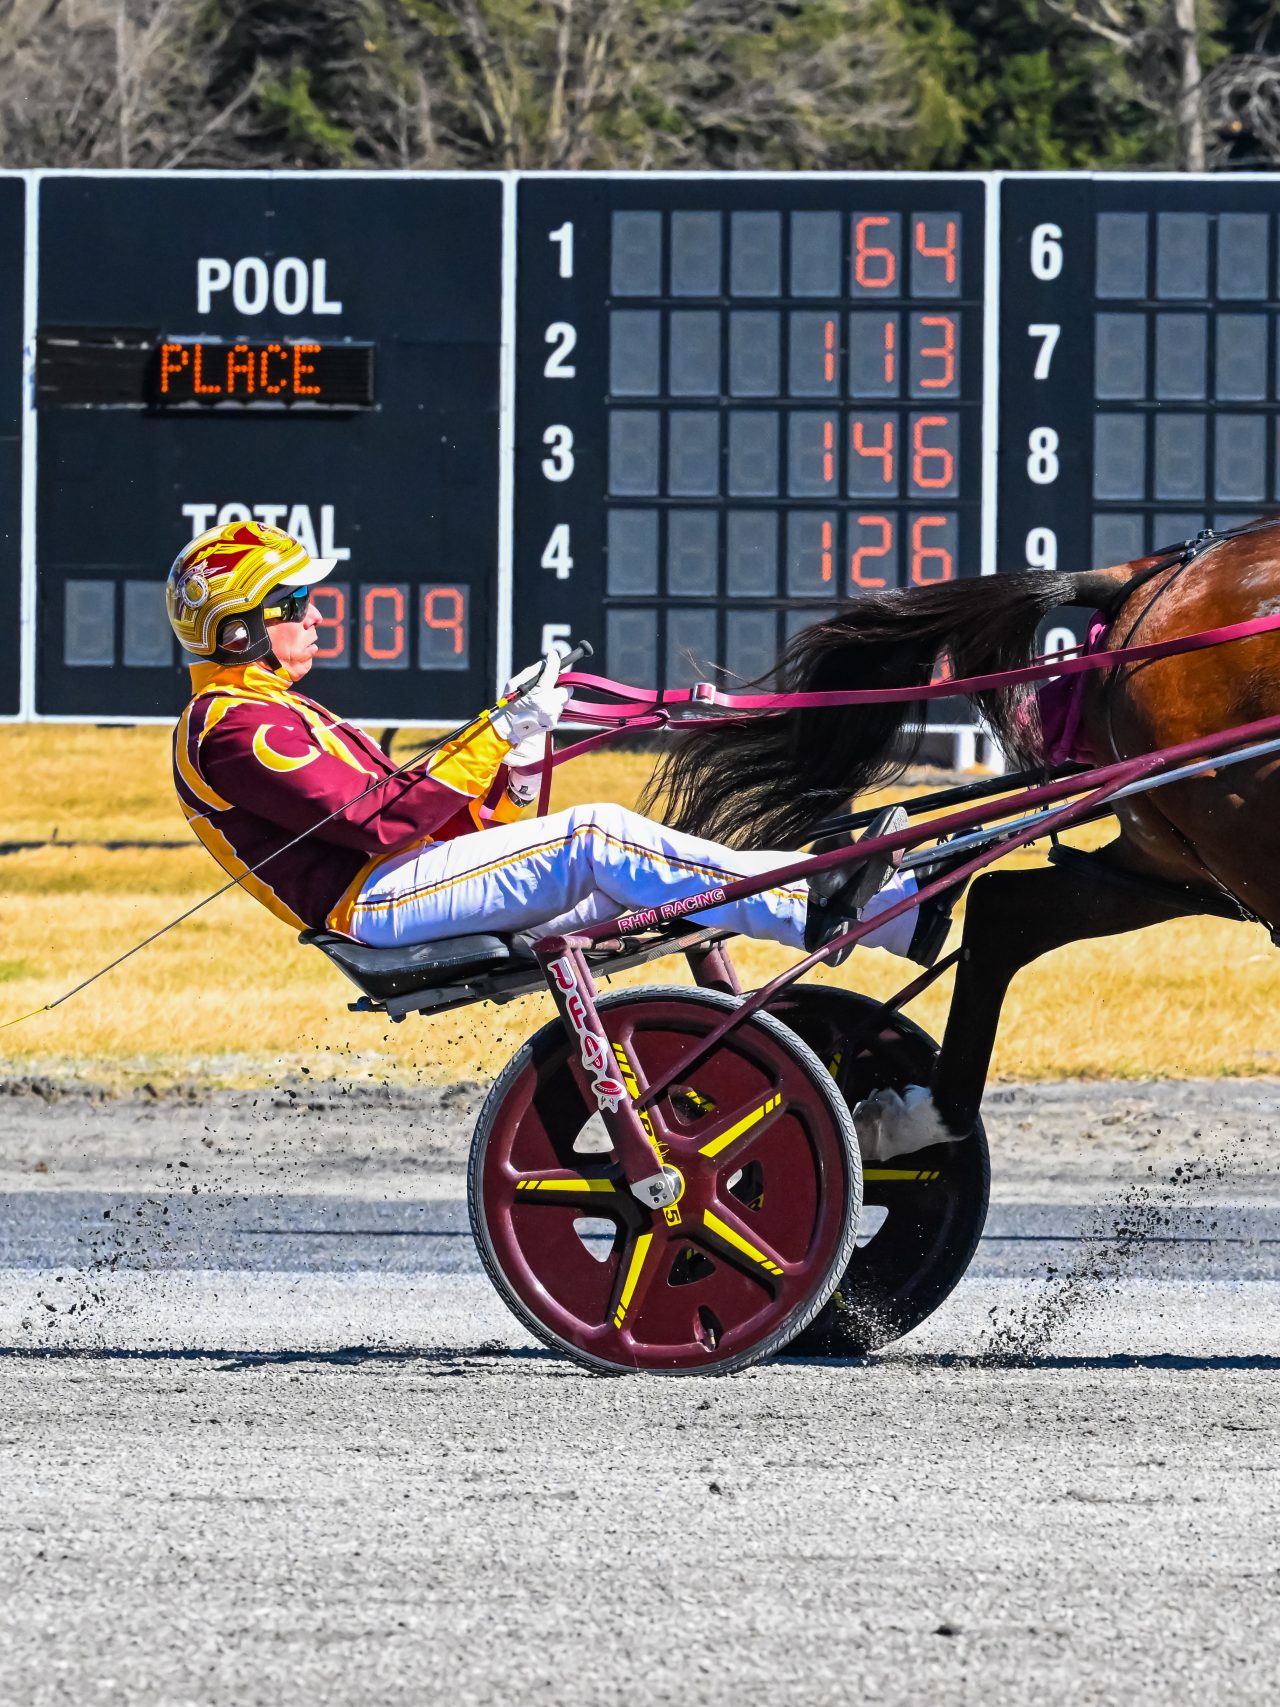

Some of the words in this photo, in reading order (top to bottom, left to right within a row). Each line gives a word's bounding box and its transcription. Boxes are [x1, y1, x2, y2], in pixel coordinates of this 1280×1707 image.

[549, 222, 573, 278] 1
[855, 217, 956, 287] 64
[1030, 223, 1063, 280] 6
[197, 257, 342, 315] POOL
[161, 343, 321, 394] PLACE
[543, 322, 577, 378] 2
[824, 316, 955, 389] 113
[1028, 324, 1061, 380] 7
[541, 424, 575, 482] 3
[823, 416, 954, 489] 146
[1027, 426, 1059, 485] 8
[182, 503, 351, 561] TTAL
[541, 524, 574, 580] 4
[822, 516, 953, 587] 126
[1025, 527, 1057, 571] 9
[618, 909, 659, 933] RHM
[660, 888, 726, 919] RACING
